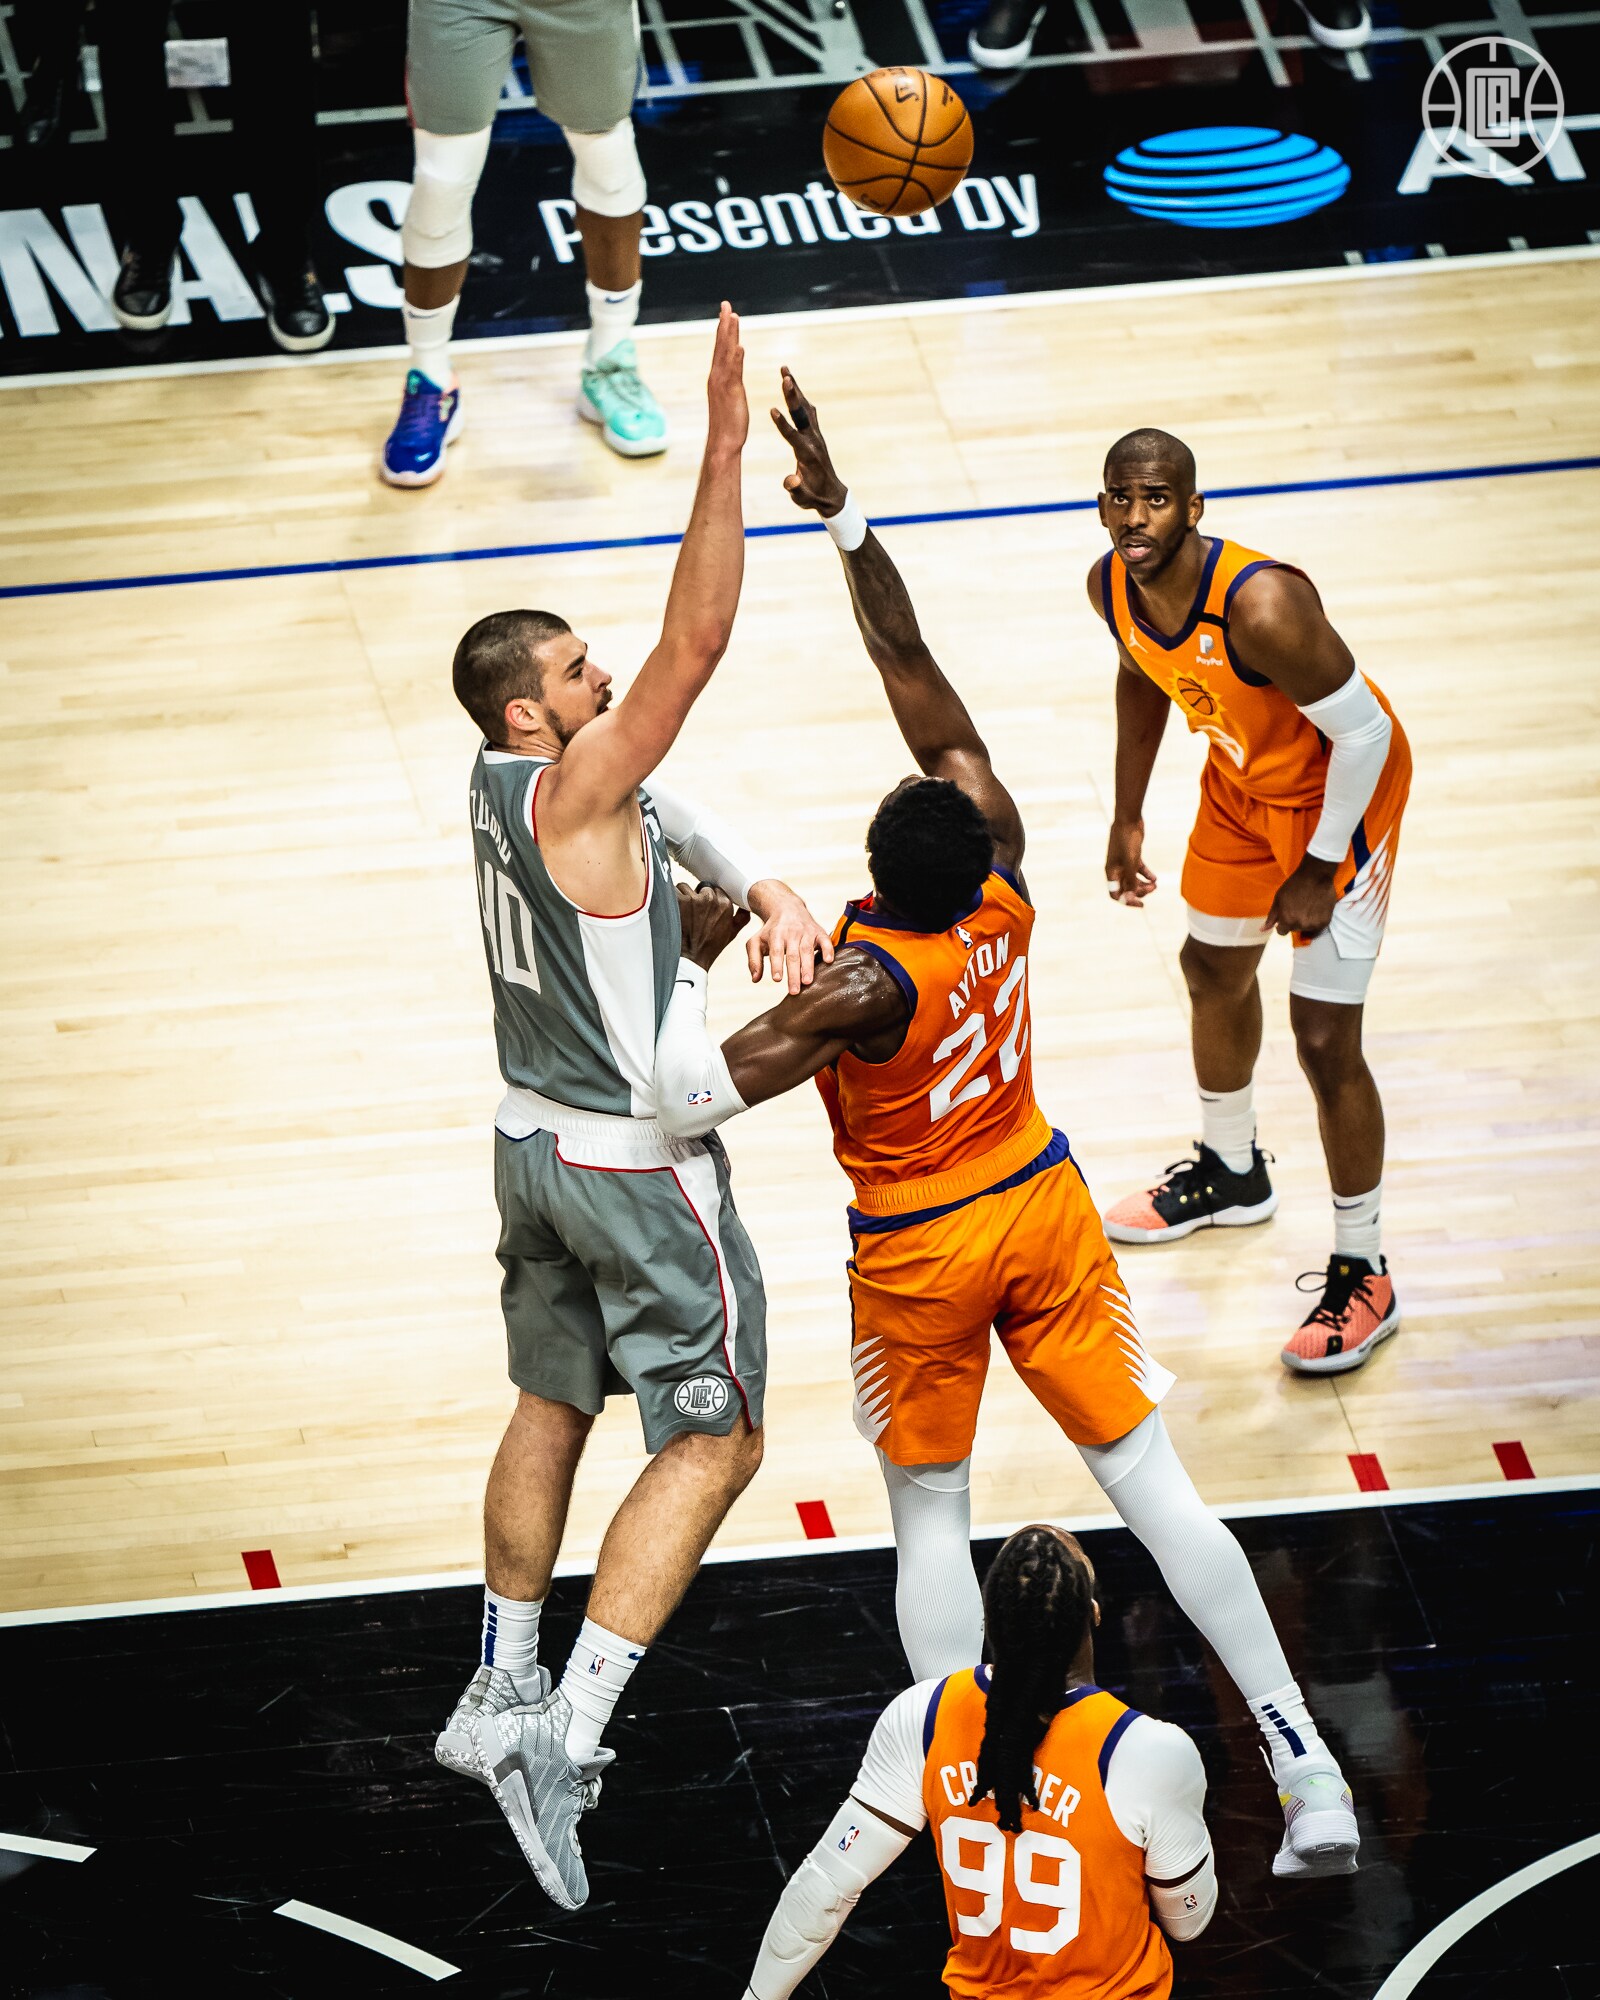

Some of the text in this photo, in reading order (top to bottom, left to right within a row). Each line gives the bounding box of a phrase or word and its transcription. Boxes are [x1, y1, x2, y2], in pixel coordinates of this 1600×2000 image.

[952, 173, 1041, 238] by
[1195, 655, 1224, 667] PayPal
[475, 857, 541, 995] 40
[948, 931, 1010, 1030] AYTON
[929, 955, 1029, 1123] 22
[939, 1760, 1082, 1829] CRDER
[939, 1815, 1082, 1956] 99
